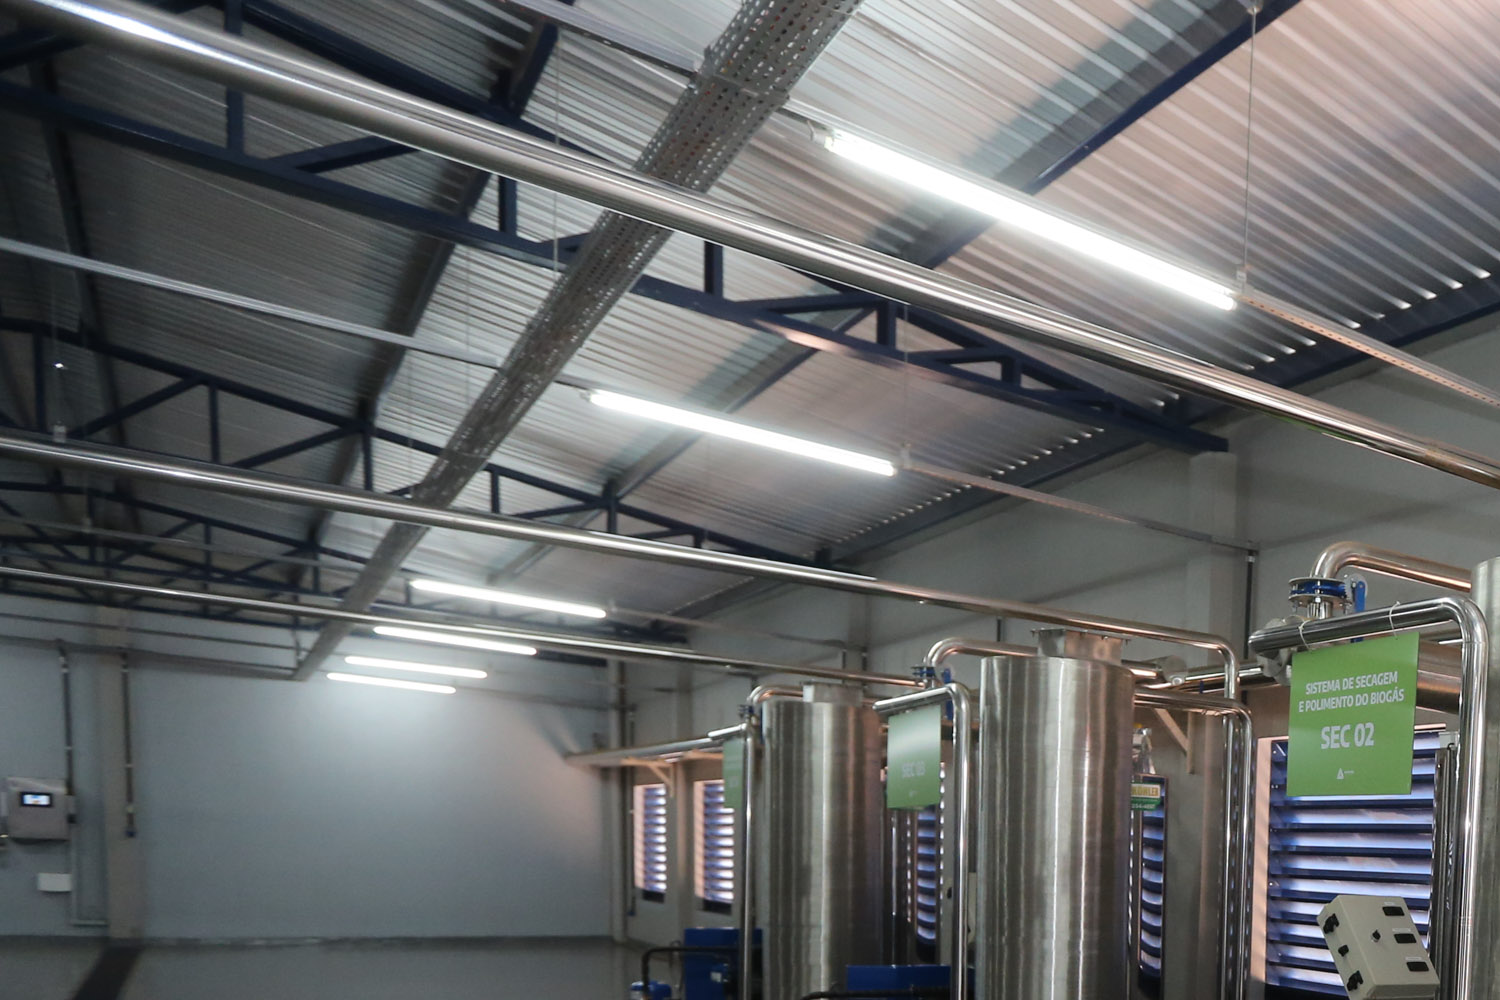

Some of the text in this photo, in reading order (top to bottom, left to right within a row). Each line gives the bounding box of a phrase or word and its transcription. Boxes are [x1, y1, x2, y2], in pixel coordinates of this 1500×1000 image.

[1305, 671, 1398, 695] SISTEMA DE SECAGEM
[1298, 687, 1405, 712] E POLIMENTO DO BIOGÁS
[1320, 722, 1375, 749] SEC 02
